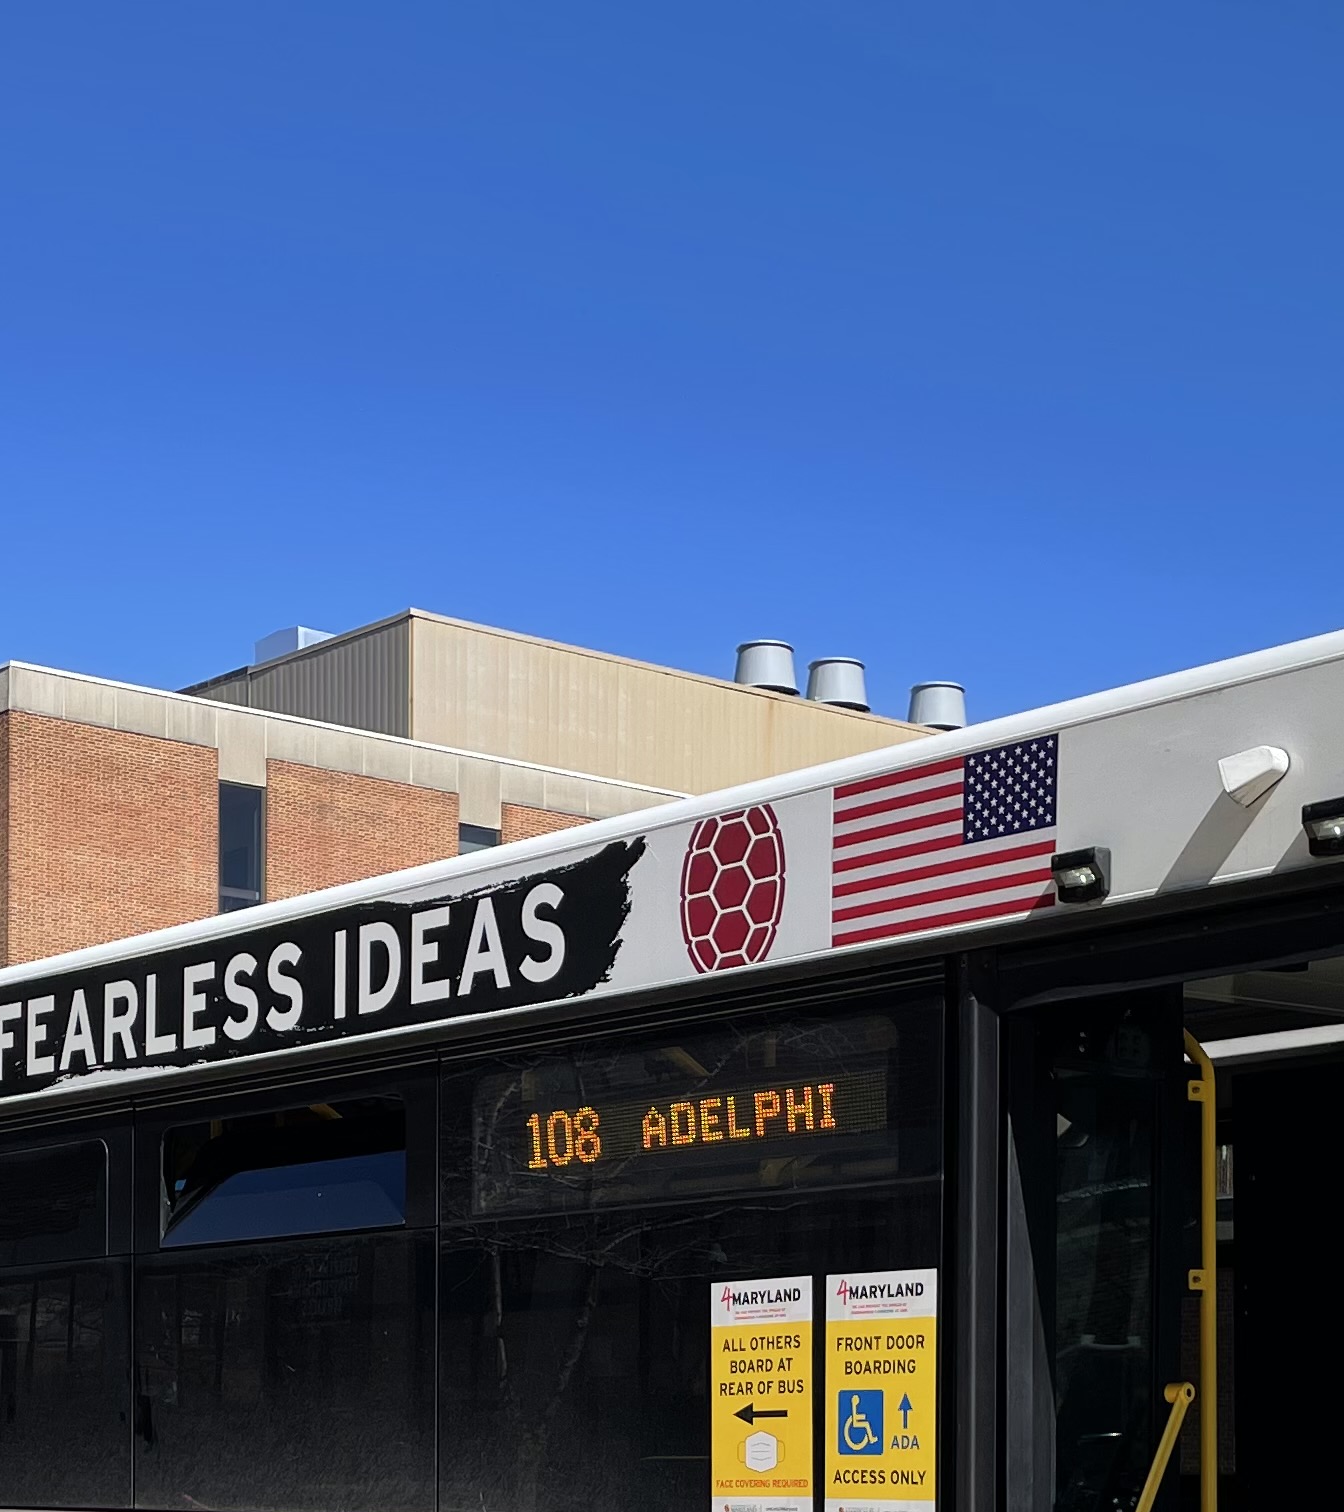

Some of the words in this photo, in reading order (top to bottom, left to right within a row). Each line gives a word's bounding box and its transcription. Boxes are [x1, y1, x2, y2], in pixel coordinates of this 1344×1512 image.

[334, 882, 566, 1021] IDEAS
[526, 1106, 601, 1169] 108
[642, 1083, 837, 1149] ADELPHI
[722, 1338, 746, 1352] ALL
[750, 1335, 801, 1351] OTHERS
[836, 1336, 881, 1351] FRONT
[886, 1334, 925, 1350] DOOR
[730, 1359, 773, 1374] BOARD
[777, 1358, 793, 1372] AT
[844, 1359, 916, 1375] BOARDING
[719, 1381, 753, 1396] REAR
[757, 1380, 774, 1395] OF
[778, 1379, 804, 1394] BUS
[891, 1435, 920, 1450] ADA
[716, 1479, 733, 1488] FACE
[735, 1479, 770, 1488] COVERING
[772, 1479, 808, 1488] REQUIRED
[833, 1469, 886, 1484] ACCESS
[890, 1469, 927, 1485] ONLY
